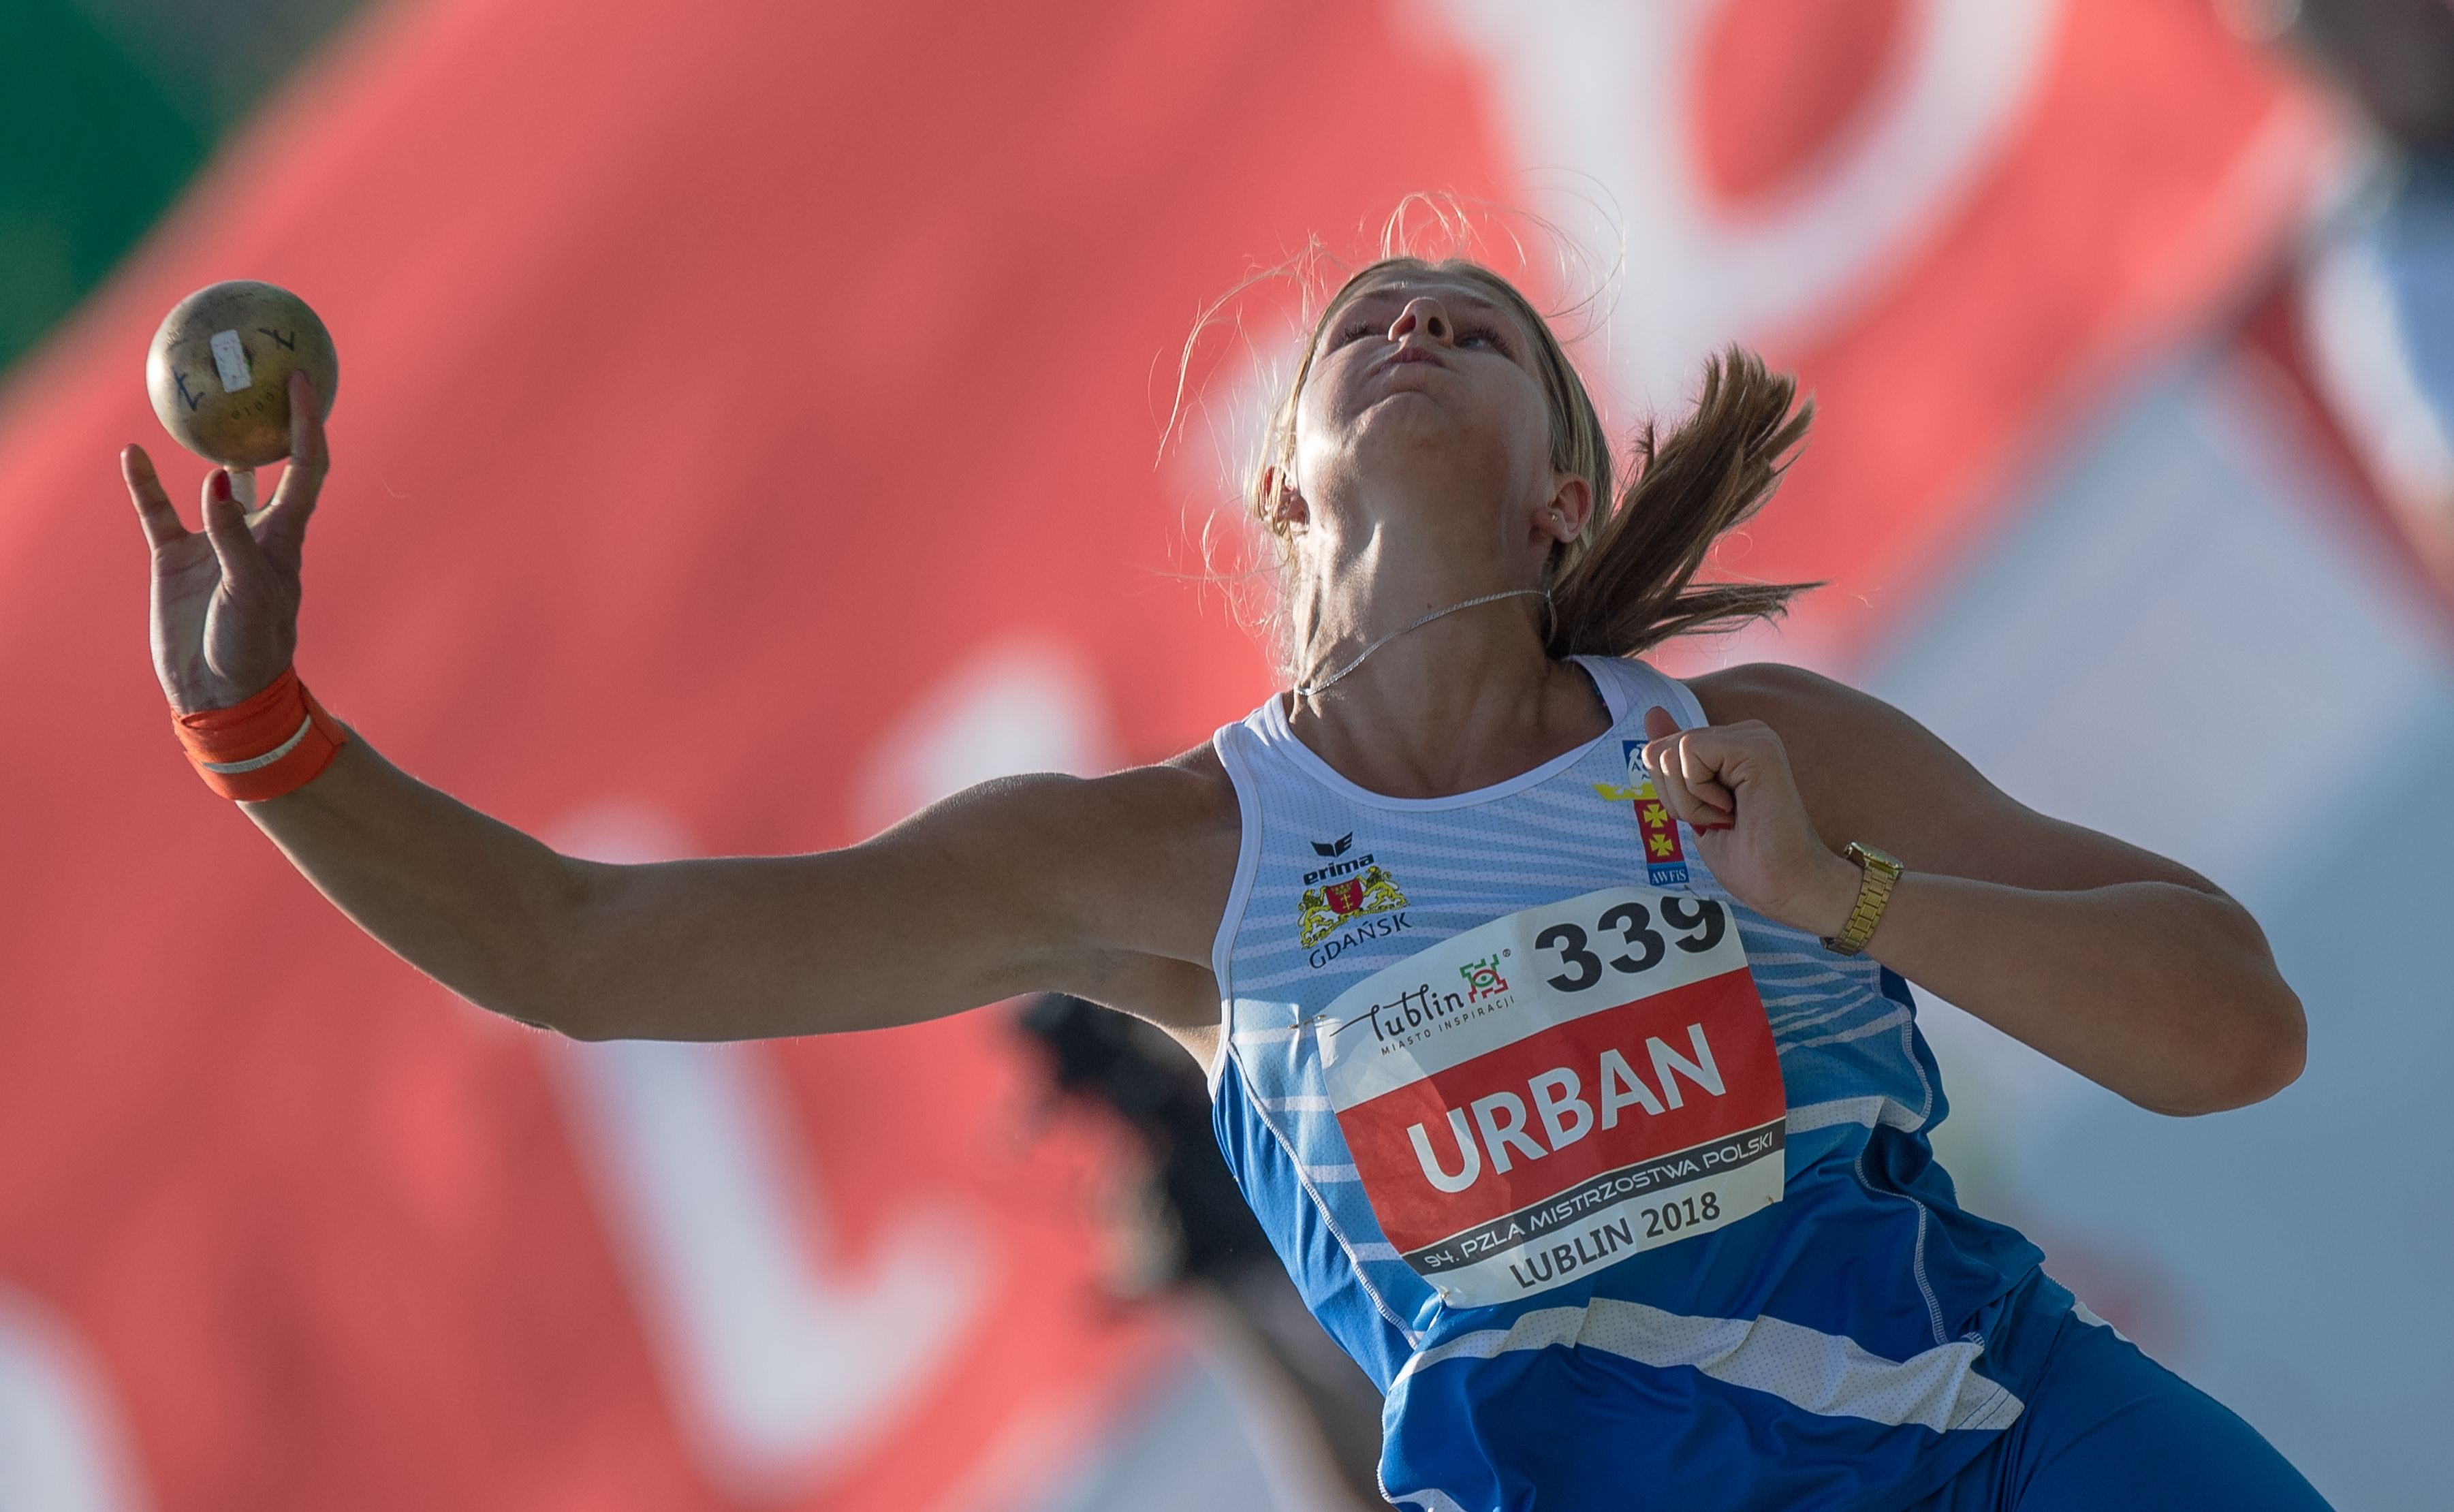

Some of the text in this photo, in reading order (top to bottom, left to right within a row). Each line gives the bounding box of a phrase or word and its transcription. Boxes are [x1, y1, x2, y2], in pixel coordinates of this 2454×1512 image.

[1303, 853, 1375, 886] erima
[1651, 868, 1687, 885] AWFiS
[1308, 912, 1413, 969] GDAŃSK
[1535, 896, 1726, 992] 339
[1381, 994, 1515, 1056] MIASTO INSPIRACJI
[1406, 1022, 1727, 1194] URBAN
[1423, 1131, 1774, 1269] 94. PZLA MISTRZOSTWA POLSKI
[1509, 1191, 1721, 1289] LUBLIN 2018
